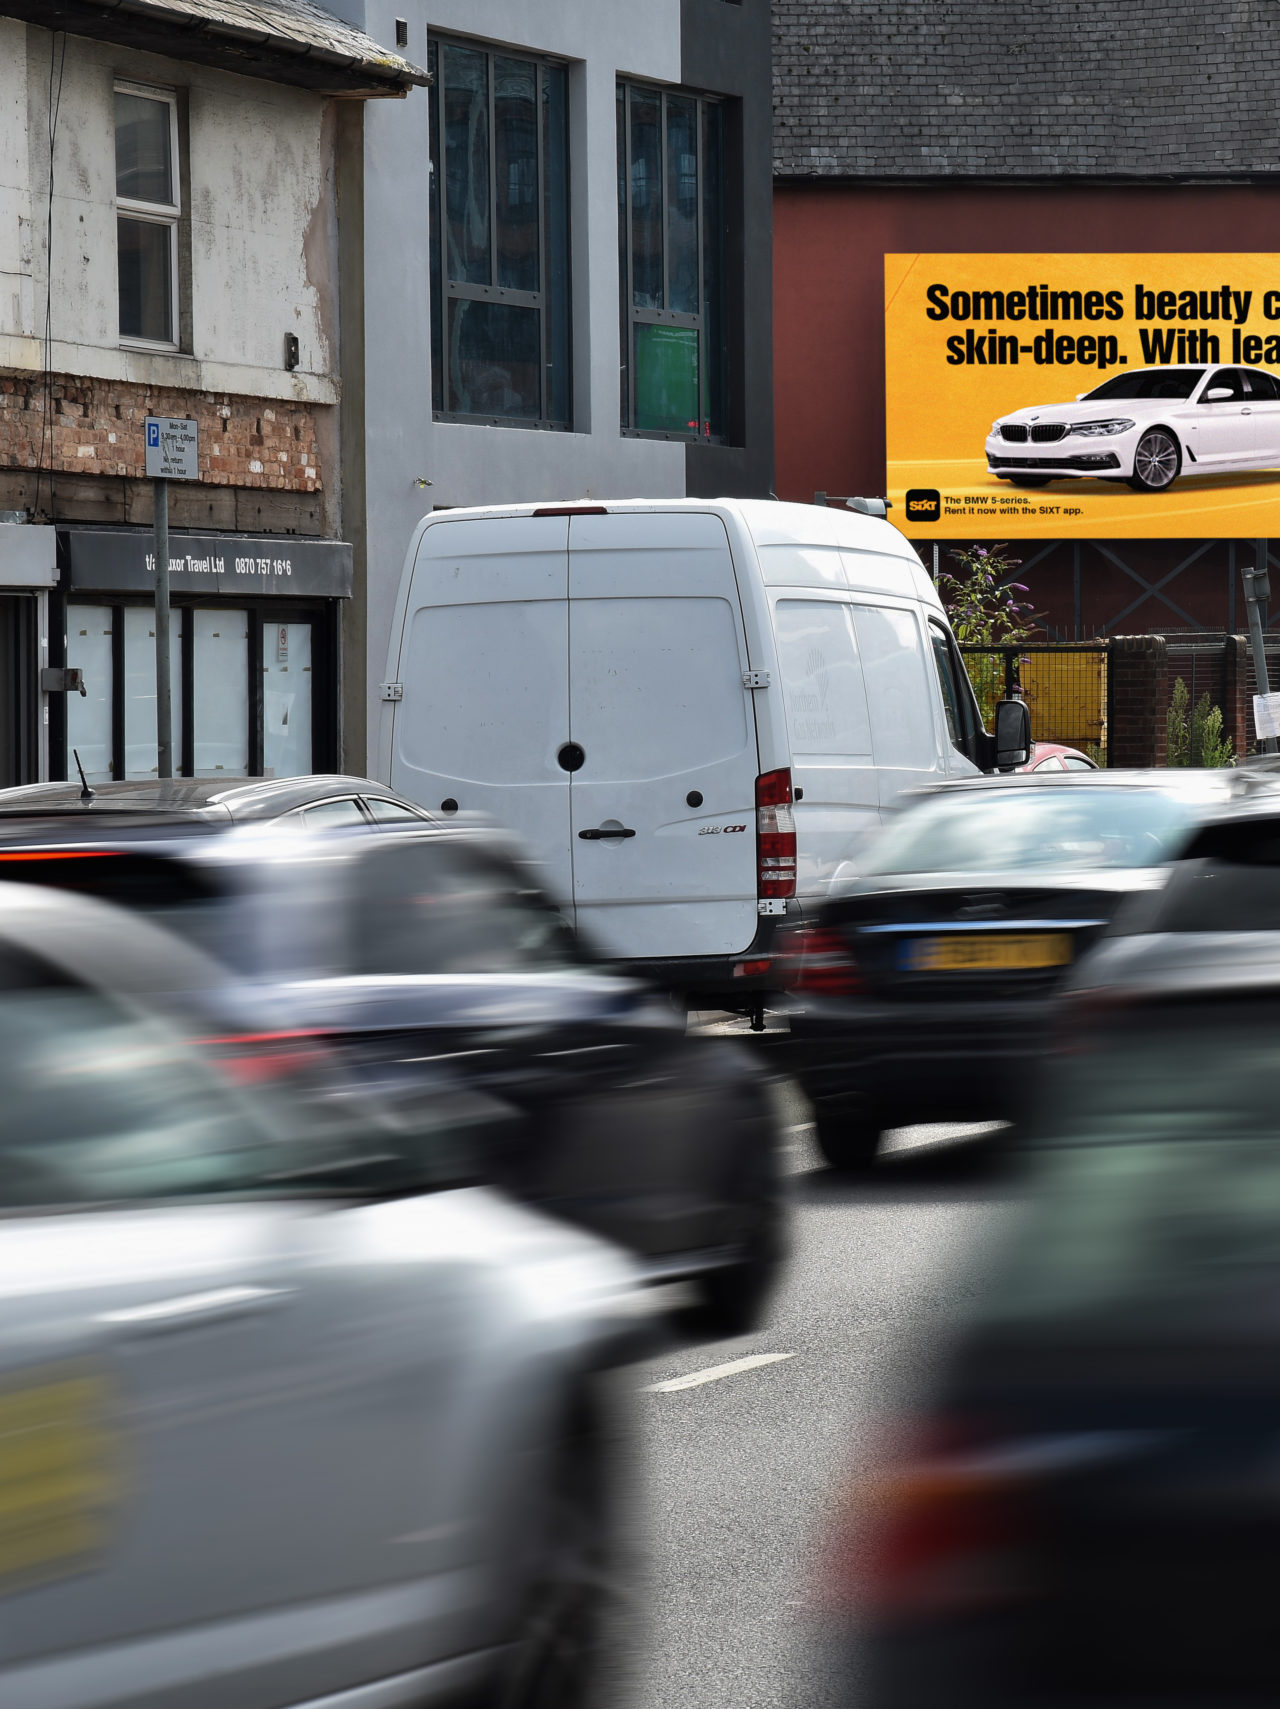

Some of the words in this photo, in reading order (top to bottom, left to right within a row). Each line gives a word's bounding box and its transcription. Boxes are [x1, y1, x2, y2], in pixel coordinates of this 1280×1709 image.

[927, 284, 1123, 321] Sometimes
[1135, 284, 1253, 324] beauty
[946, 329, 1128, 370] skin-deep.
[1139, 329, 1220, 364] With
[169, 422, 188, 430] Mon-Sat
[175, 445, 186, 453] hour
[177, 467, 187, 475] hour
[944, 496, 962, 504] The
[964, 496, 989, 504] BMW
[991, 496, 1031, 504] 5-series.
[944, 507, 966, 515] Rent
[968, 506, 975, 515] it
[1000, 506, 1019, 515] with
[1022, 506, 1037, 515] the
[1039, 506, 1061, 515] SIXT
[1063, 508, 1084, 516] app.
[168, 557, 185, 572] uxor
[186, 555, 210, 573] Travel
[211, 556, 225, 573] Ltd
[235, 557, 255, 574] 0870
[256, 558, 271, 575] 757
[698, 826, 722, 836] 313
[723, 825, 747, 834] CDI
